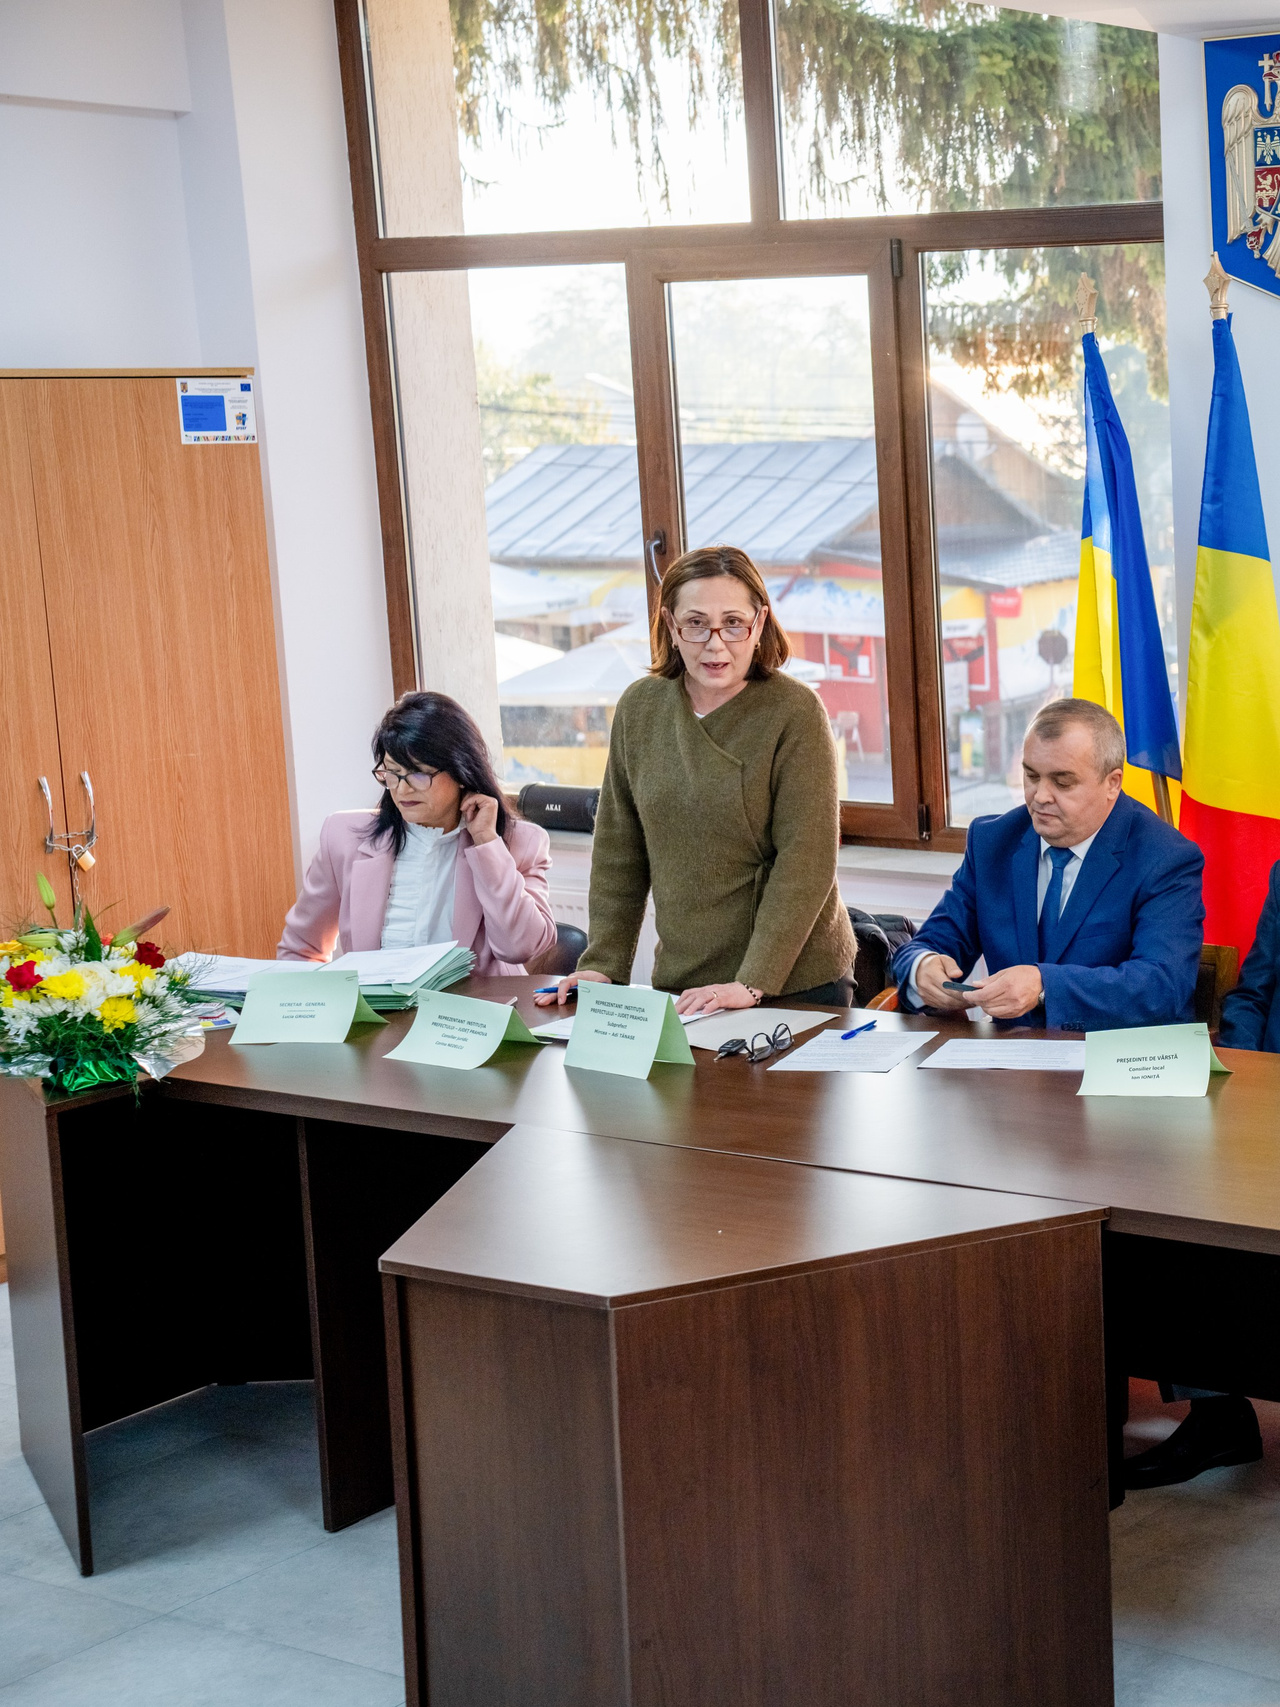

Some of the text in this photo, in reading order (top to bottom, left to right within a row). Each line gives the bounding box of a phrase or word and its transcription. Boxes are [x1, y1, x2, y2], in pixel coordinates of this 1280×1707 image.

[545, 803, 561, 811] AKAI
[595, 1000, 623, 1009] REPREZENTANT
[438, 1015, 465, 1024] REPREZENTANT
